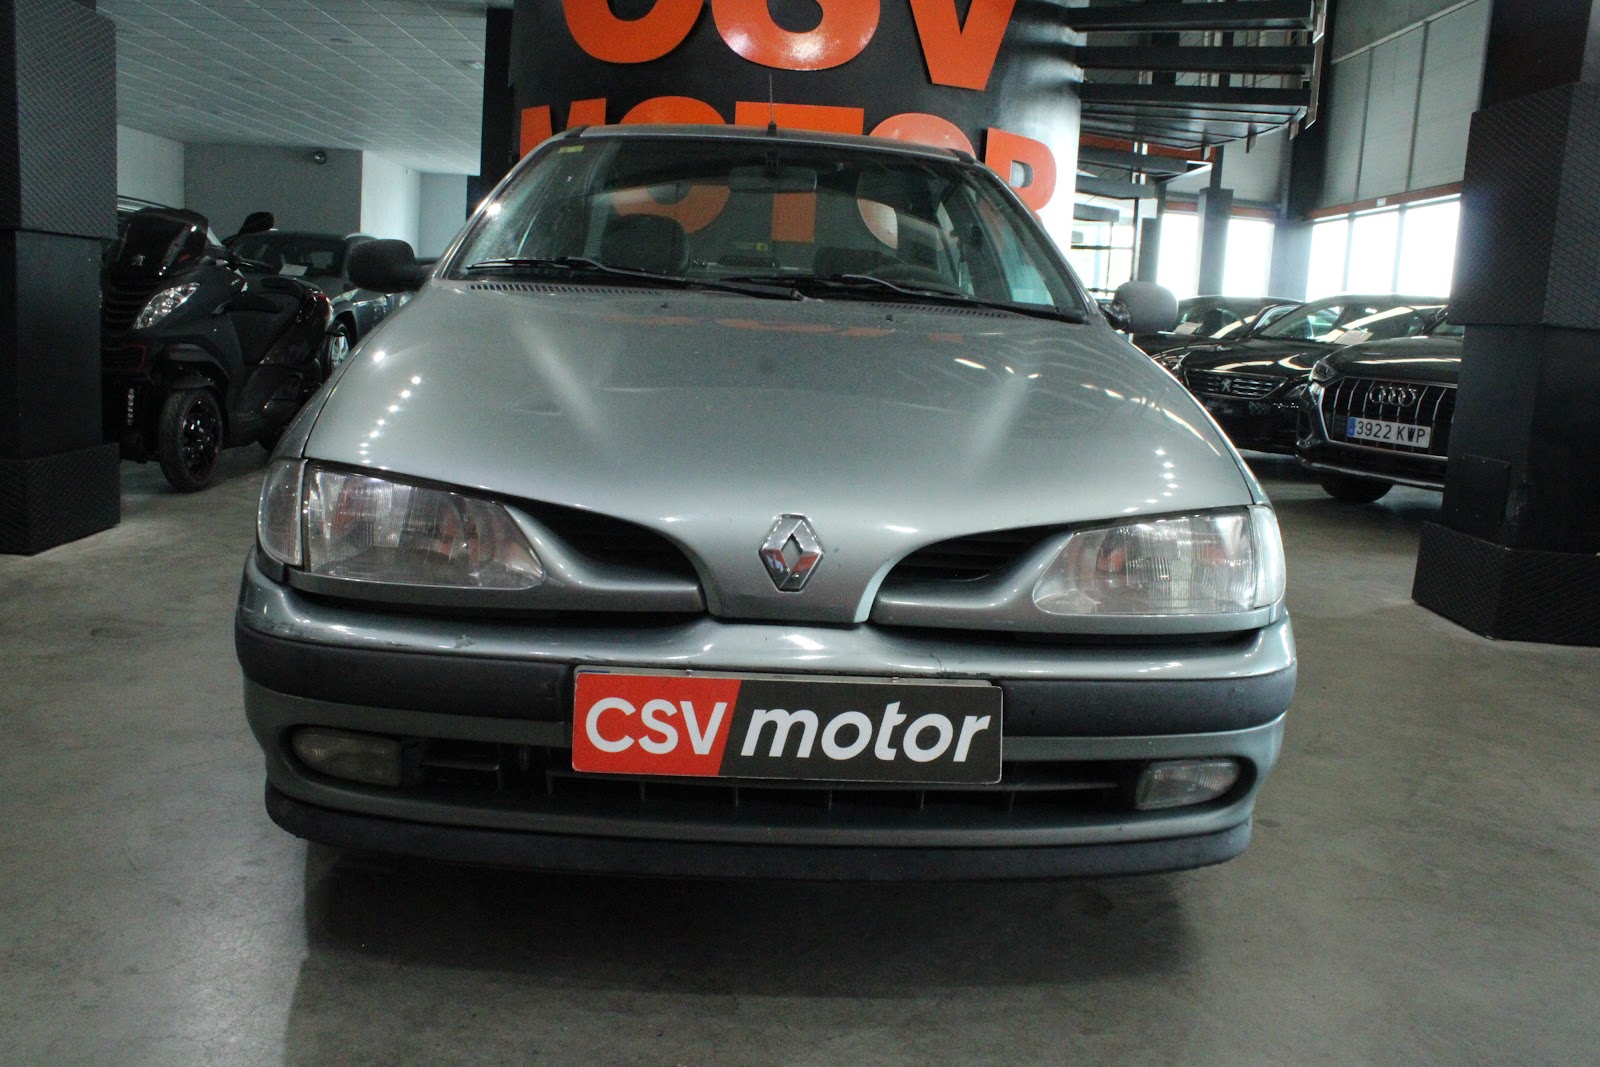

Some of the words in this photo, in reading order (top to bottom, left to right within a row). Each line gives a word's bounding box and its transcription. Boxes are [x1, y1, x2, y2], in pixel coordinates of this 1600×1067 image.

[1356, 421, 1392, 439] 3922
[1397, 425, 1426, 443] KWP
[585, 696, 728, 755] CSV
[740, 701, 991, 763] motor
